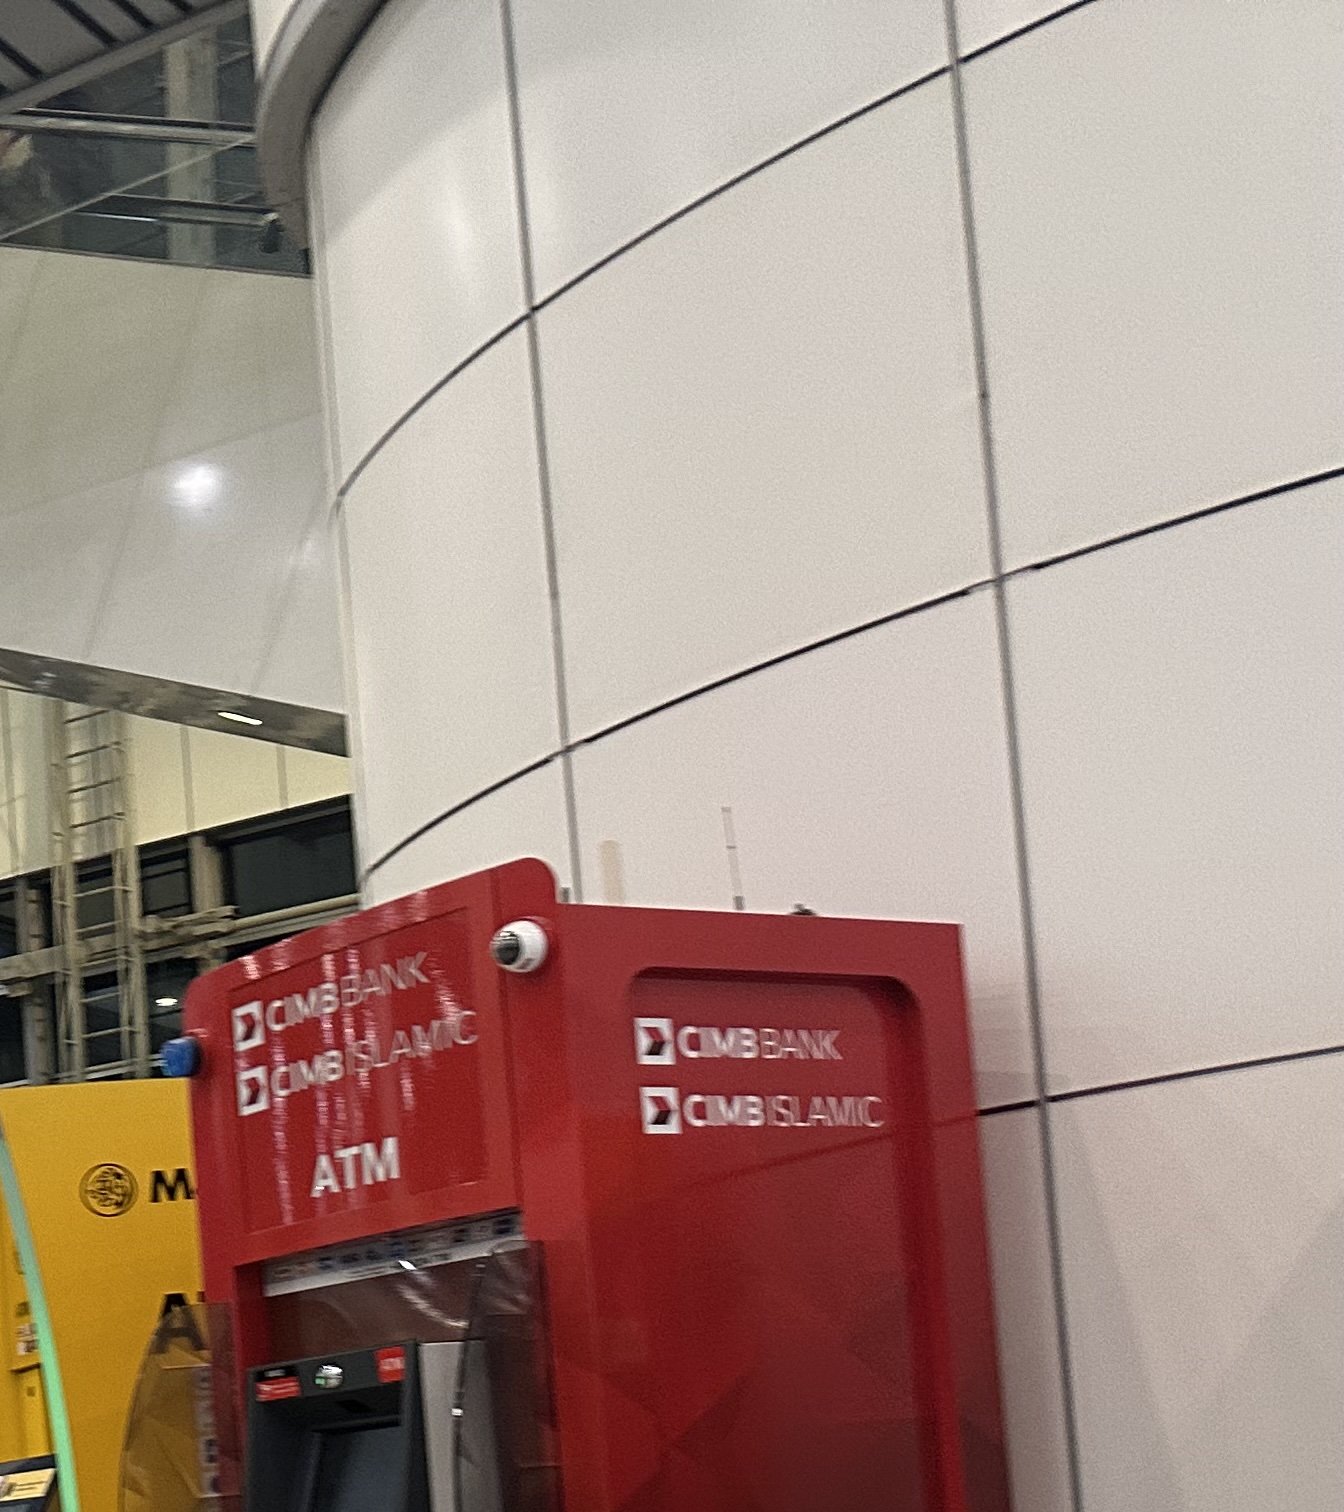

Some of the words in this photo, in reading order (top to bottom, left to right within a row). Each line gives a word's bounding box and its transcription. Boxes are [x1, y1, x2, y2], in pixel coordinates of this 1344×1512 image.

[266, 983, 340, 1033] CIMB
[340, 952, 430, 1007] BANK
[271, 1050, 345, 1097] CIMB
[345, 1010, 479, 1076] ISLAMIC
[676, 1025, 760, 1059] CIMB
[759, 1027, 844, 1060] BANK
[682, 1094, 766, 1127] CIMB
[766, 1094, 885, 1128] ISLAMIC
[149, 1168, 196, 1203] M
[310, 1136, 401, 1198] ATM
[150, 1291, 206, 1354] A
